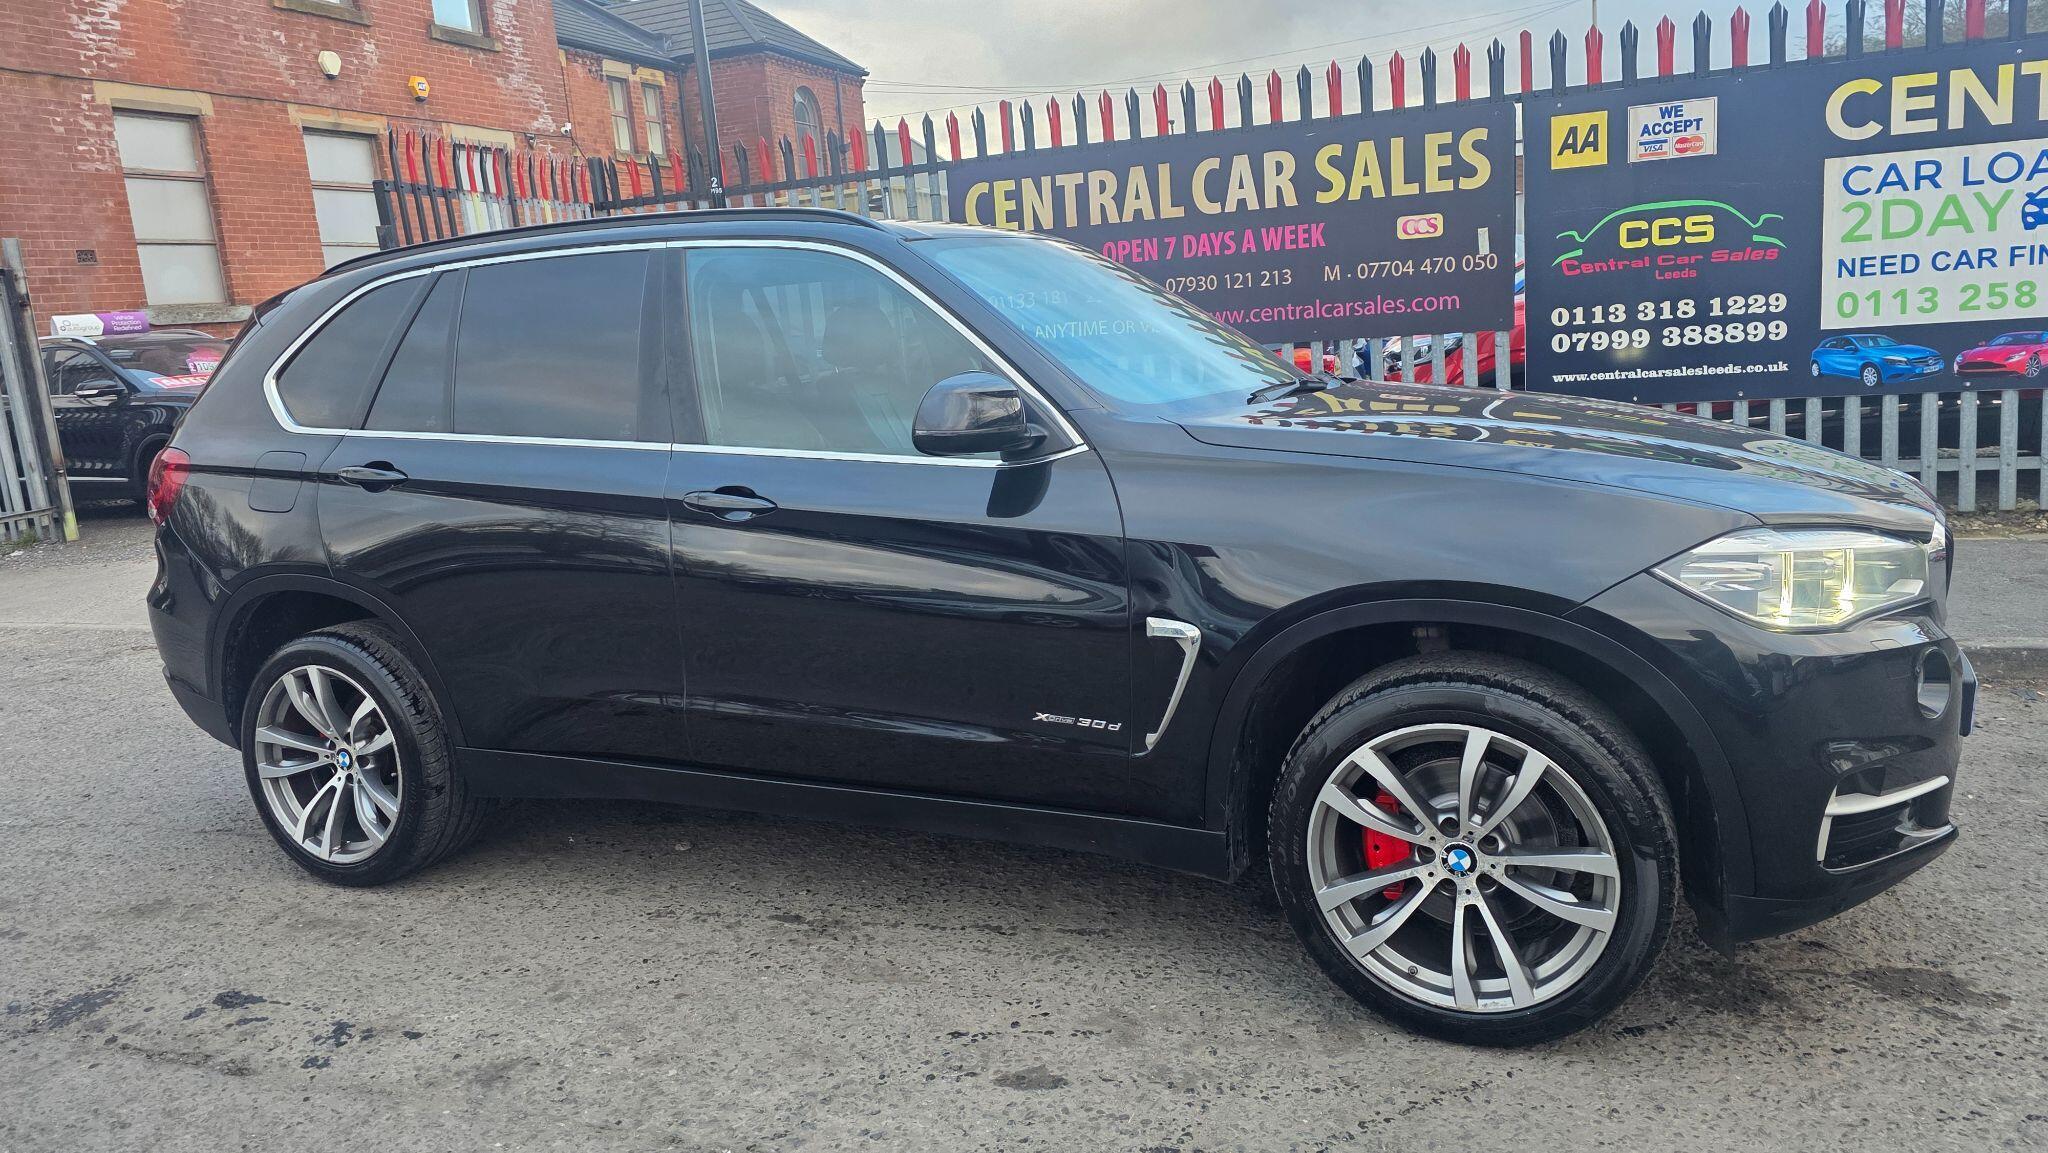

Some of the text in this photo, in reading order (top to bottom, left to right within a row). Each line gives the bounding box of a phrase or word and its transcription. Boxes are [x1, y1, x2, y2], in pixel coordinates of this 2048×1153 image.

[1640, 117, 1703, 137] ACCEPT
[1659, 104, 1684, 119] WE
[1557, 124, 1599, 156] AA
[1644, 144, 1663, 152] VISA
[1674, 141, 1704, 149] MasterCard
[710, 176, 718, 188] 2
[964, 127, 1491, 231] CENTRAL CAR SALES
[1842, 160, 1943, 196] CAR
[1840, 188, 2015, 243] 2DAY
[1102, 222, 1326, 264] OPEN 7 DAYS A WEEK
[1619, 215, 1715, 249] CCS
[1166, 275, 1217, 293] 07930
[1224, 272, 1252, 288] 121
[1260, 269, 1292, 287] 213
[1324, 265, 1340, 281] M
[1357, 260, 1414, 279] 07704
[1420, 256, 1456, 274] 470
[1462, 253, 1498, 271] 050
[1561, 247, 1779, 277] Central Car Sales
[1655, 268, 1697, 280] Leeds
[1837, 253, 1920, 278] NEED
[1931, 247, 1998, 272] CAR
[1551, 293, 1787, 326] 0113 318 1229
[1837, 280, 2038, 319] 0113 258
[1035, 320, 1108, 339] ANYTIME
[1113, 319, 1135, 334] OR
[1551, 320, 1788, 353] 07999 388899
[1552, 361, 1789, 383] www.centralcarsalesleeds.co.uk
